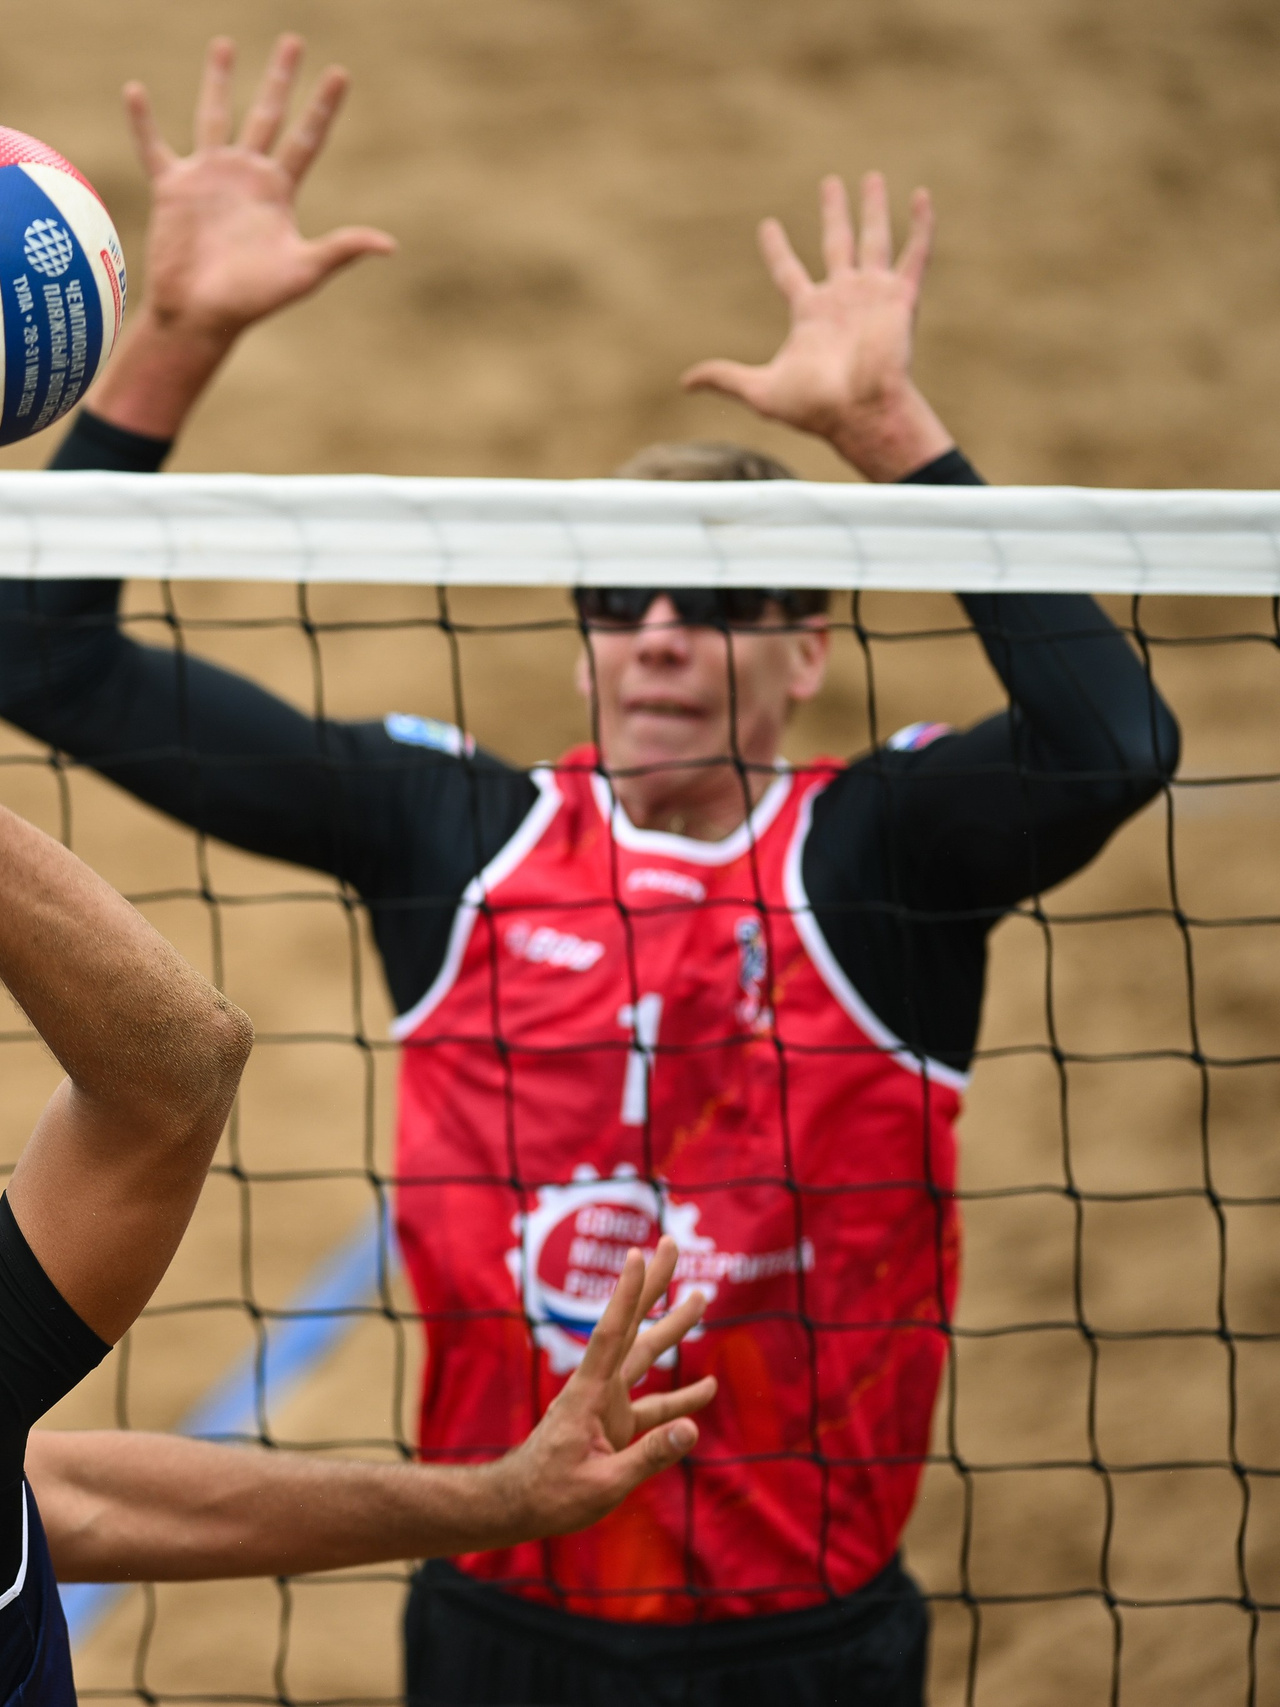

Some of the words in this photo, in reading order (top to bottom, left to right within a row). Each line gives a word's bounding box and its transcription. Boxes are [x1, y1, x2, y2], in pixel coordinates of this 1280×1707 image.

[13, 274, 33, 313] ТУЛА
[24, 325, 38, 364] 28-31
[42, 283, 70, 371] ПЛЯЖНЫЙ
[617, 993, 663, 1126] 1
